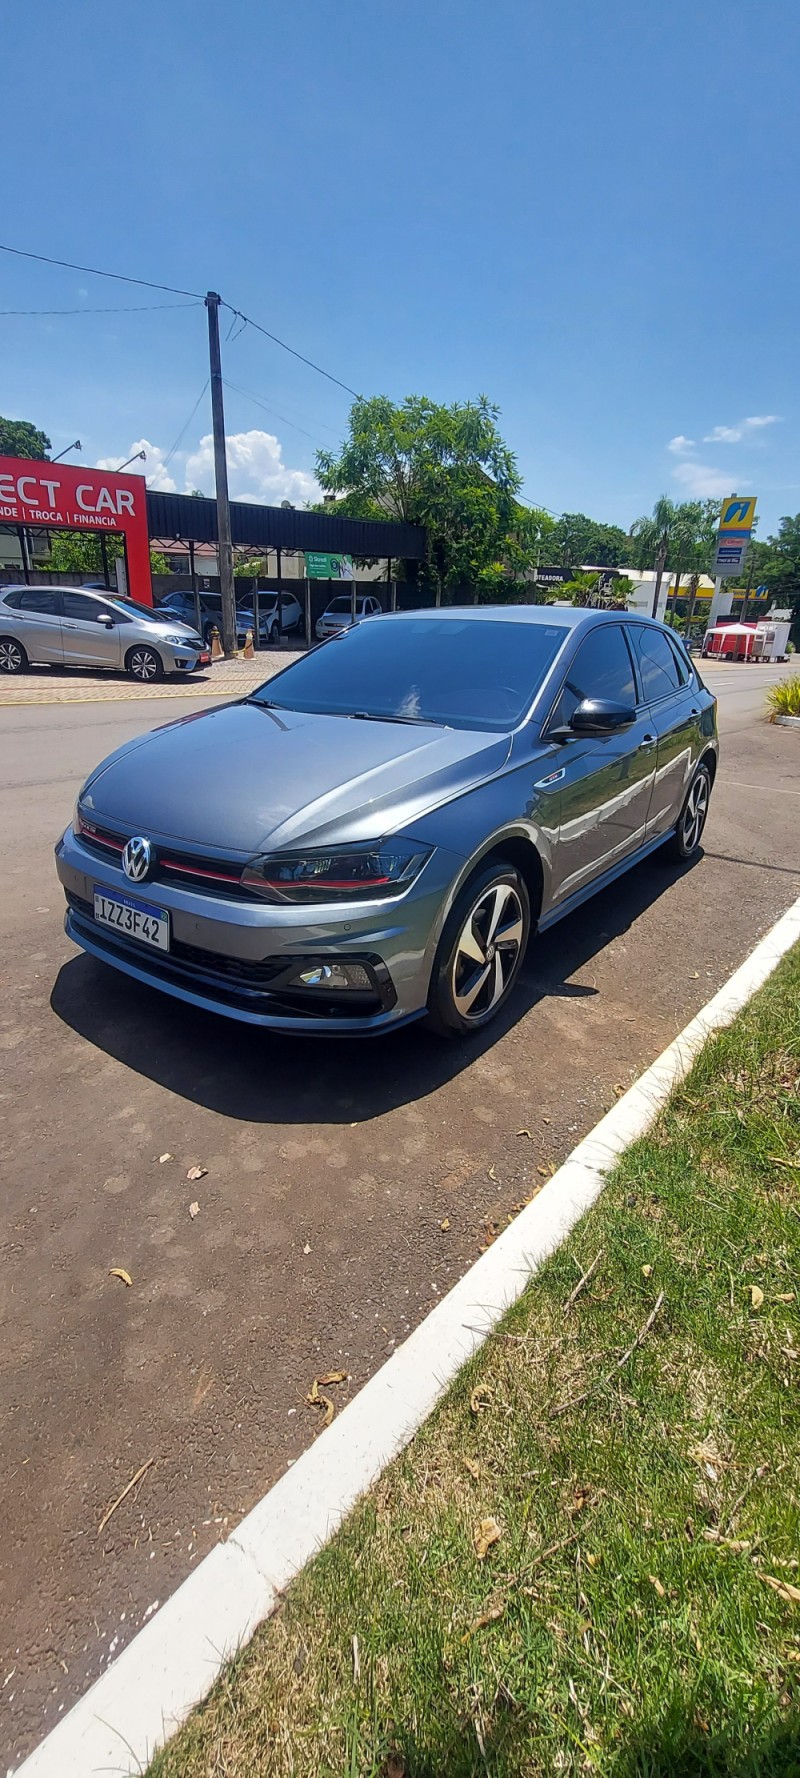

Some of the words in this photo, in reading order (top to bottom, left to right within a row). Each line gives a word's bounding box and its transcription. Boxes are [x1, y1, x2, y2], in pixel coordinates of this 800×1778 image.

[75, 484, 136, 517] CAR
[28, 509, 63, 522] TROCA
[73, 513, 117, 527] FINANCIA
[100, 898, 160, 943] IZZ3F42
